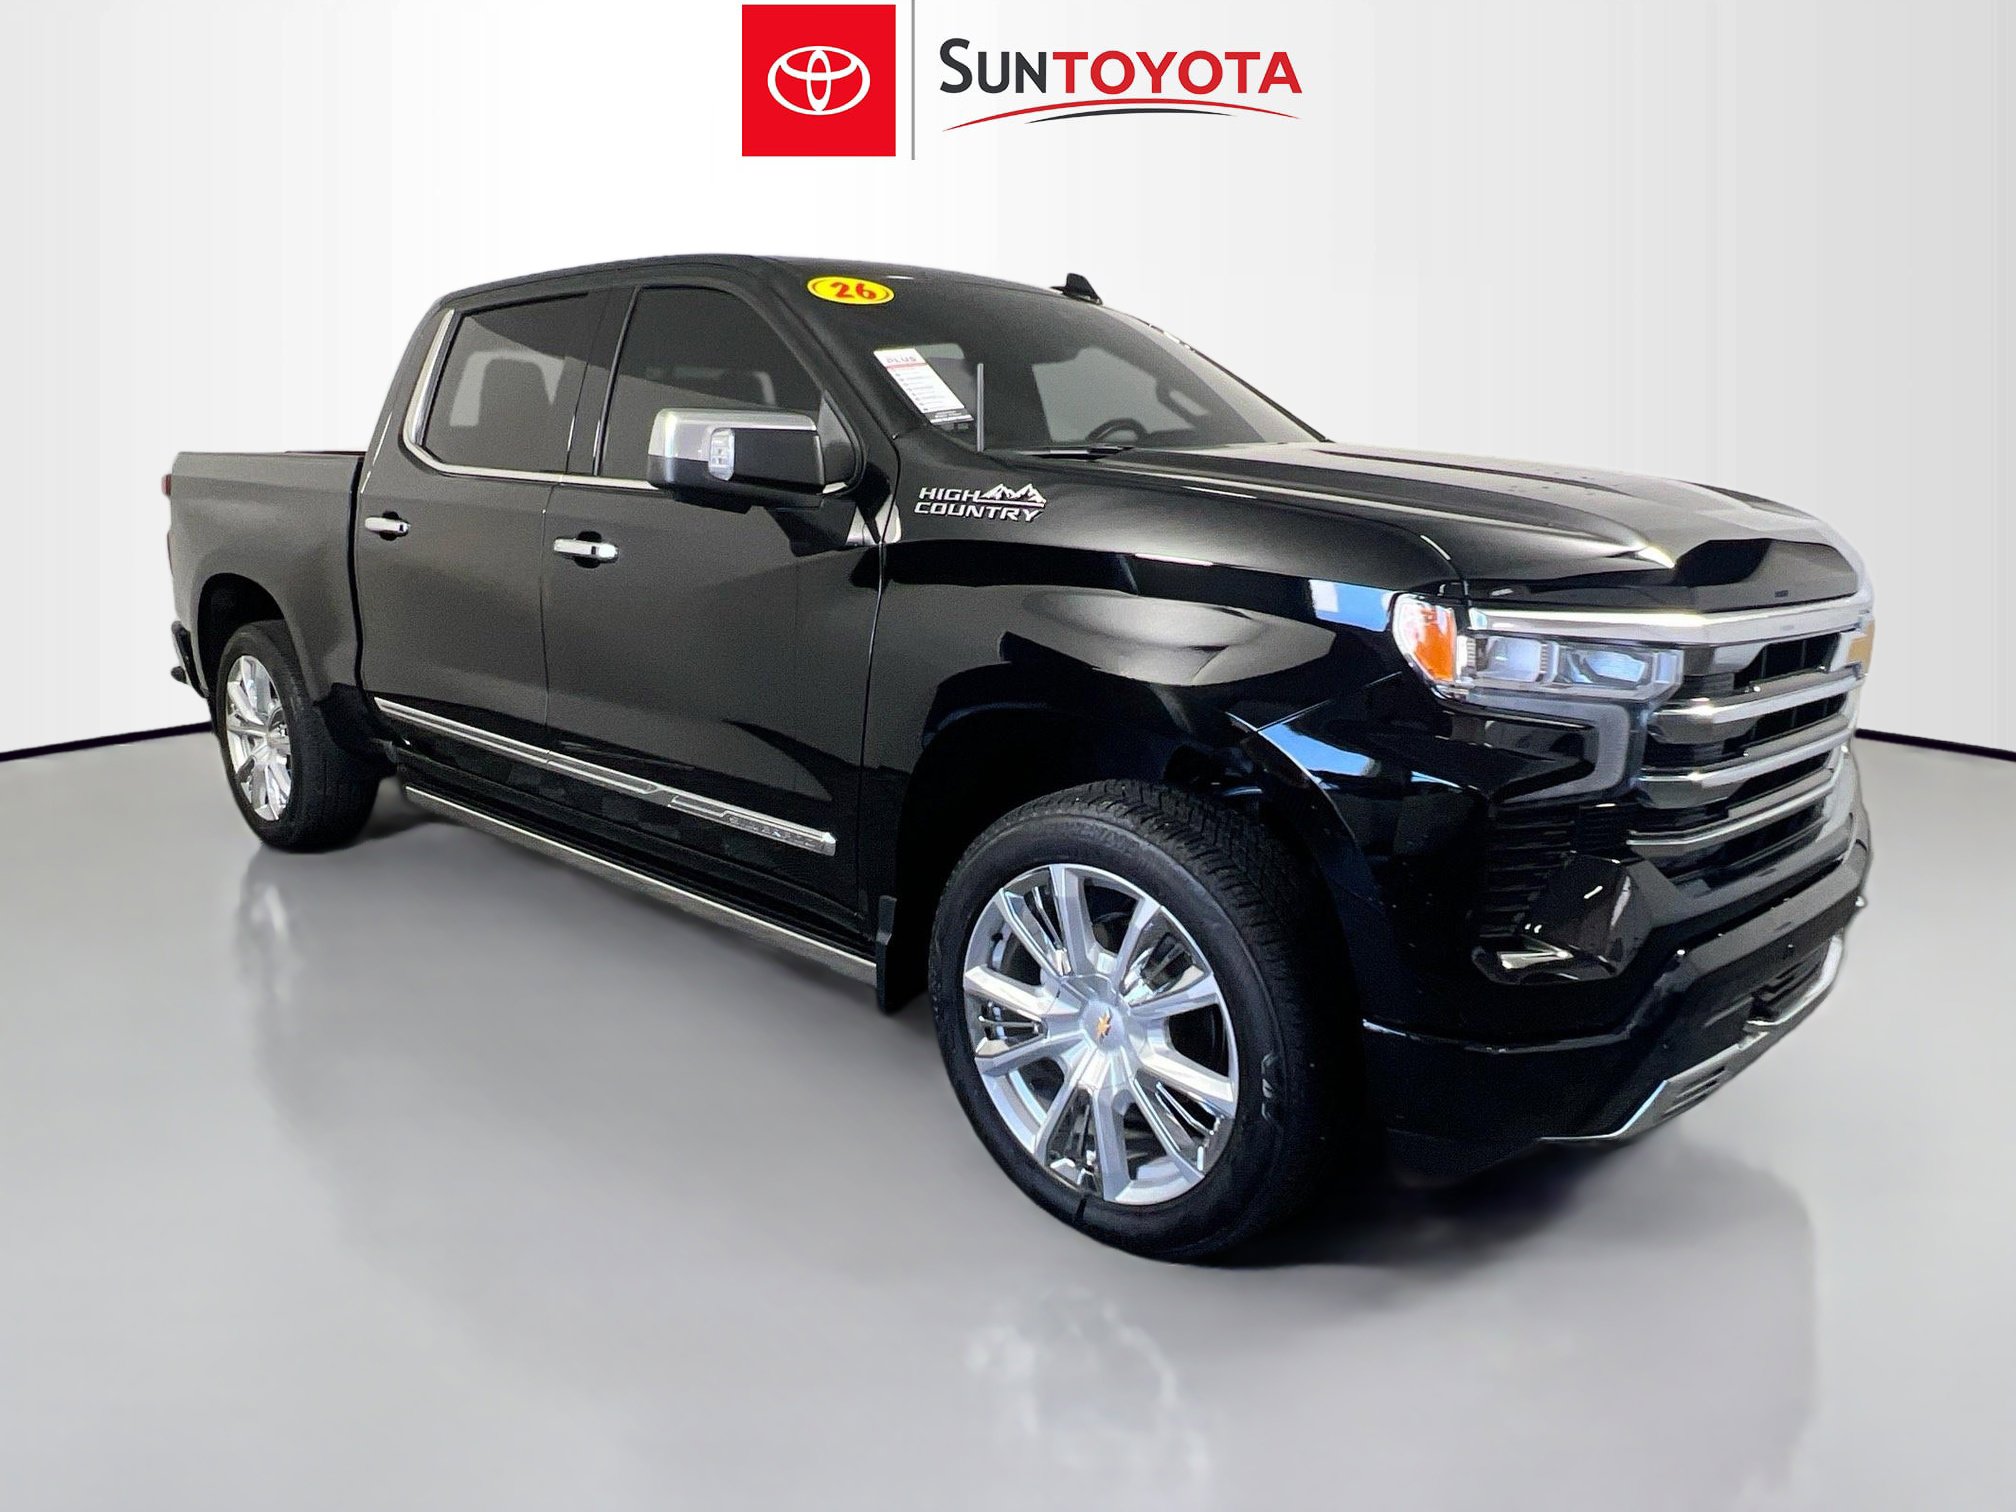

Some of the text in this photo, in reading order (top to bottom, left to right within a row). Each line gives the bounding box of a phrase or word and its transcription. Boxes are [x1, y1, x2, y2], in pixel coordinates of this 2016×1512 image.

[830, 281, 877, 300] 26
[918, 487, 981, 502] HIGH
[914, 501, 1044, 522] COUNTRY
